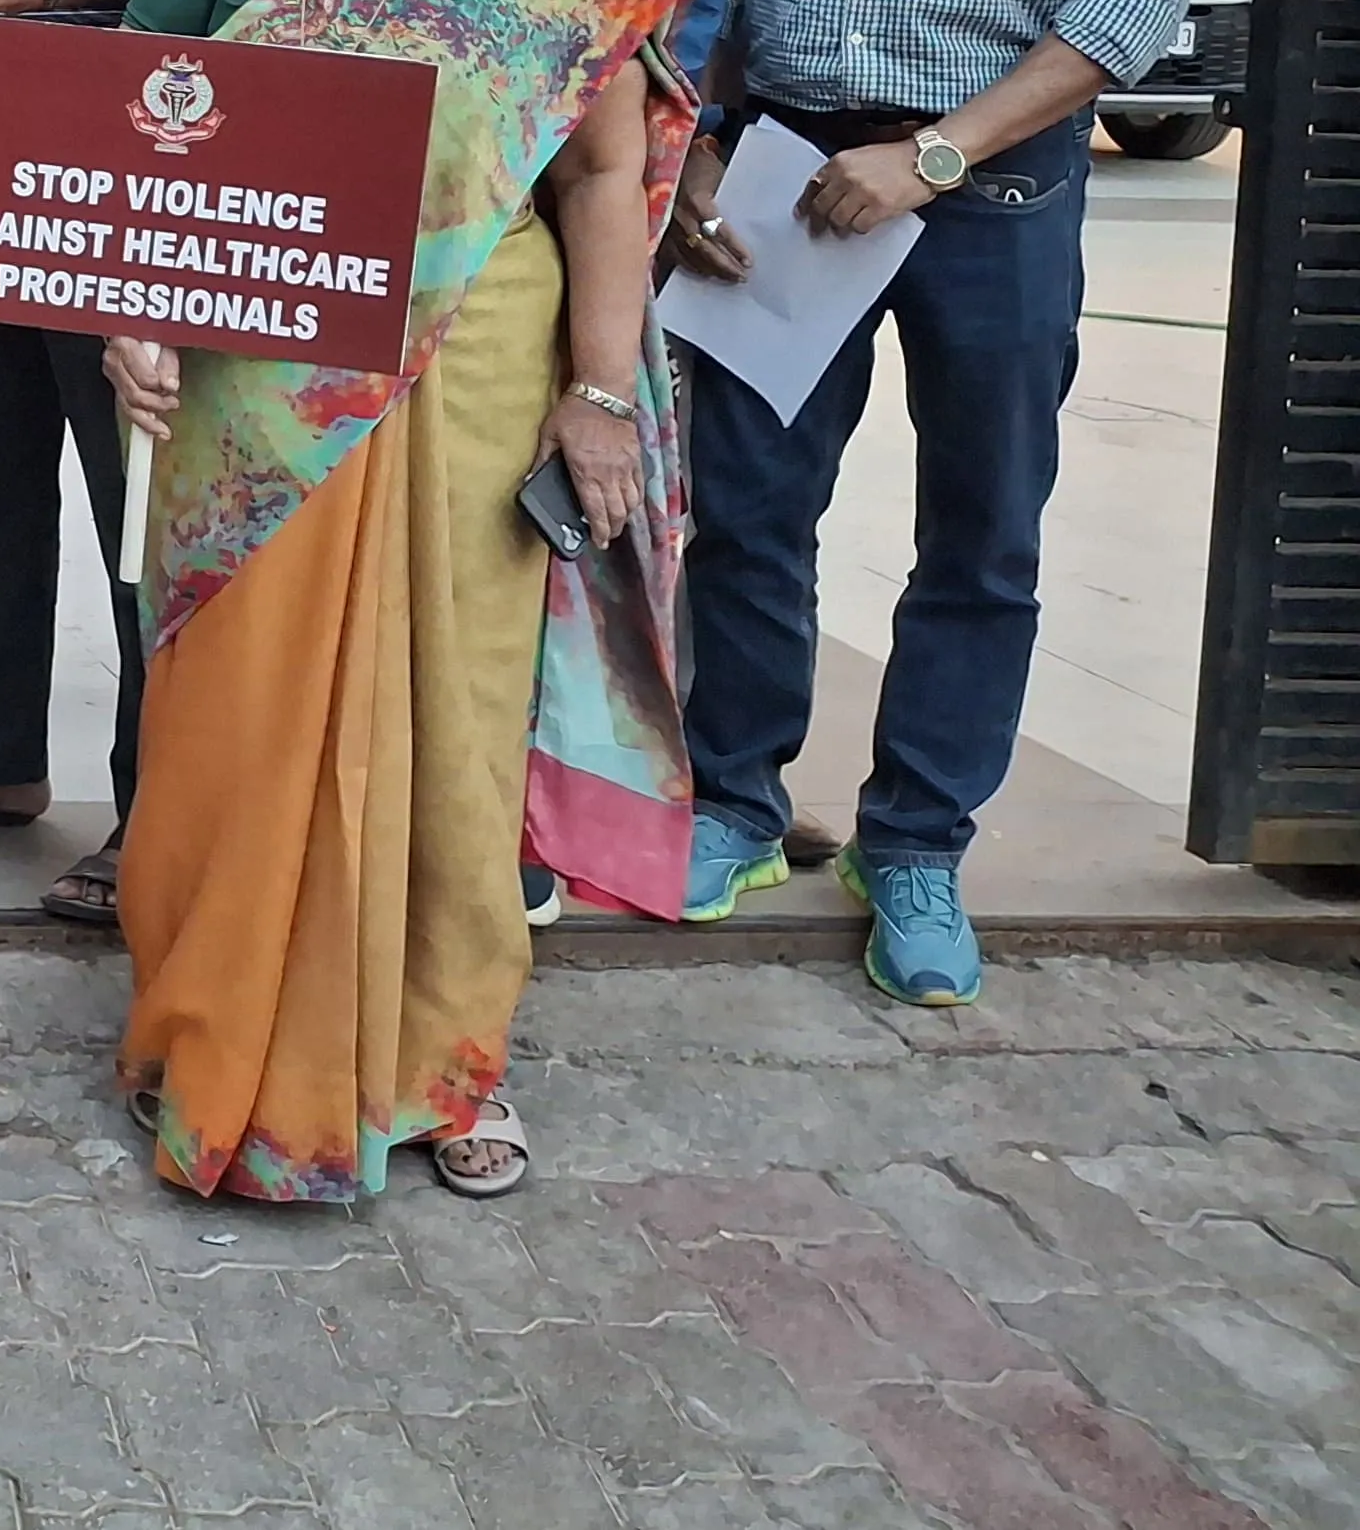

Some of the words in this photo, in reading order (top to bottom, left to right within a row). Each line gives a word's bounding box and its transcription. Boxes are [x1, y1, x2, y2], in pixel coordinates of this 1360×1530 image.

[11, 161, 113, 207] STOP
[125, 173, 327, 234] VIOLENCE
[122, 227, 390, 298] HEALTHCARE
